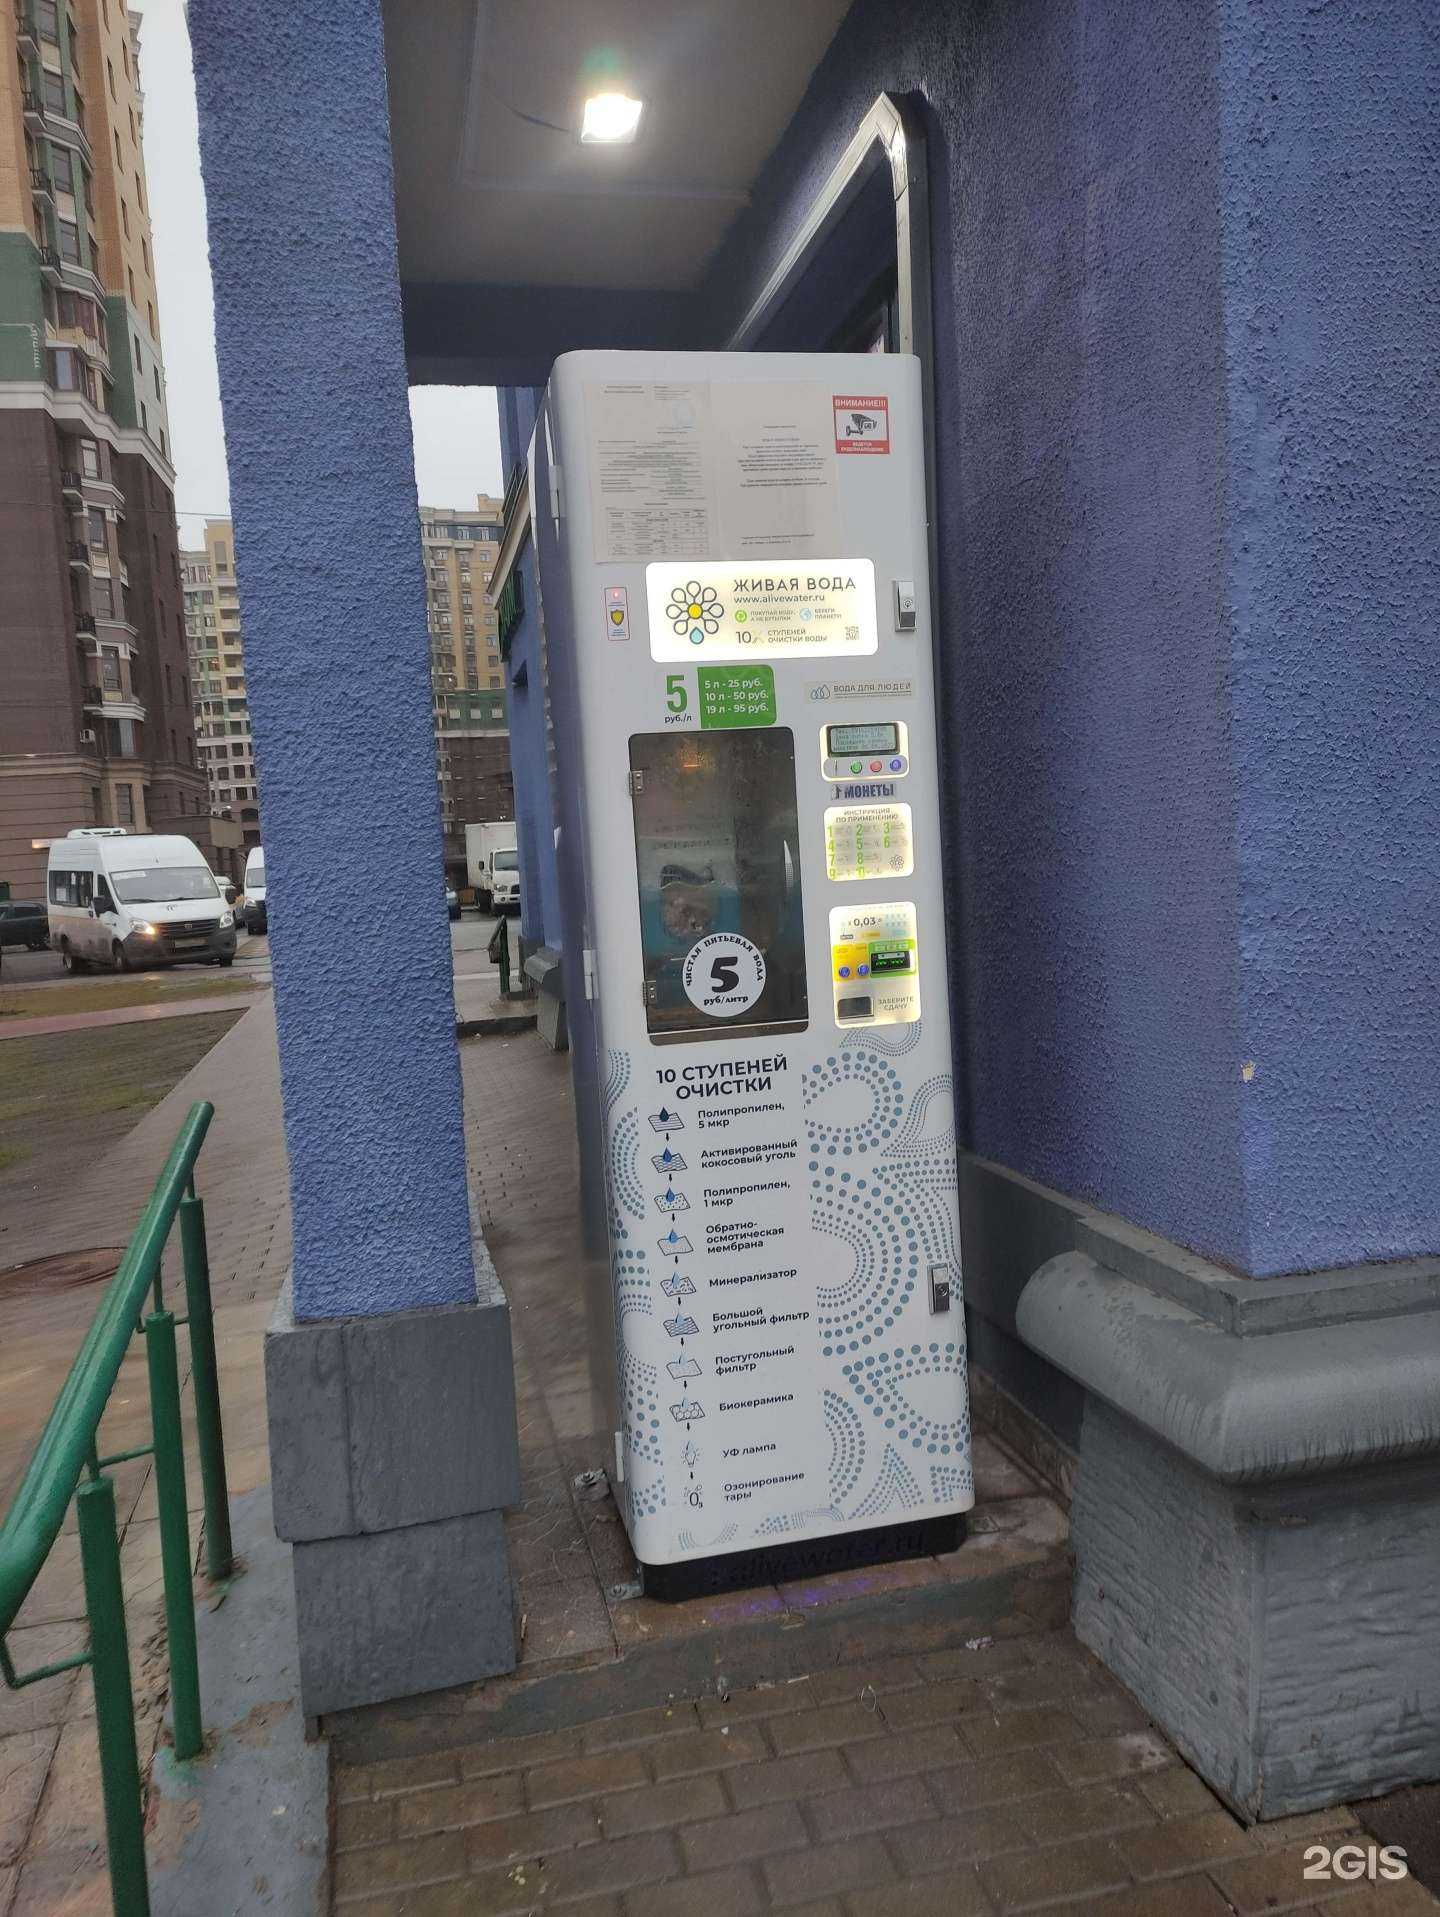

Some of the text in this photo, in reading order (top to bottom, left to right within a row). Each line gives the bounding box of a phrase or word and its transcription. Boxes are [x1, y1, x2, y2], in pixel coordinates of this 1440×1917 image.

[733, 576, 857, 593] ЖИВАЯ ВОДА
[733, 593, 825, 604] www.alivewater.ru
[735, 630, 751, 644] 10
[767, 628, 806, 636] СТУПЕНЕЙ
[704, 680, 711, 688] 5
[727, 679, 740, 688] 25
[742, 678, 763, 690] руб.
[833, 681, 911, 692] ВОДА ДЛЯ ЛЮДЕЙ
[666, 675, 688, 713] 5
[705, 692, 715, 701] 10
[733, 691, 745, 700] 50
[748, 690, 769, 702] руб.
[705, 705, 715, 714] 19
[718, 706, 725, 714] л
[733, 704, 745, 713] 95
[748, 703, 769, 715] руб.
[664, 713, 692, 724] руб./л
[845, 783, 894, 799] МОНЕТЫ
[856, 824, 863, 836] 2
[883, 822, 890, 834] 3
[828, 840, 835, 852] 4
[856, 839, 863, 850] 5
[883, 836, 890, 849] 6
[828, 854, 836, 866] 7
[856, 852, 864, 864] 8
[711, 956, 740, 993] 5
[703, 995, 749, 1006] руб/литр
[656, 1053, 788, 1084] 10 СТУПЕНЕЙ
[676, 1076, 772, 1099] ОЧИСТКИ
[698, 1102, 785, 1119] Полипропилен,
[698, 1119, 730, 1129] 5 мкр
[701, 1139, 798, 1159] Активированный
[701, 1151, 796, 1168] кокосовый уголь
[704, 1180, 791, 1198] Полипропилен,
[704, 1197, 734, 1208] 1 мкр
[706, 1221, 758, 1235] Обратно-
[706, 1227, 784, 1244] осмотическая
[707, 1240, 764, 1254] мембрана
[709, 1268, 797, 1287] Минерализатор
[712, 1306, 763, 1321] Большой
[713, 1310, 810, 1333] угольный фильтр
[715, 1345, 795, 1365] Постугольный
[715, 1362, 757, 1377] фильтр
[719, 1393, 794, 1412] Биокерамика
[722, 1443, 776, 1458] УФ лампа
[724, 1472, 805, 1492] Озонирование
[724, 1490, 752, 1502] тары
